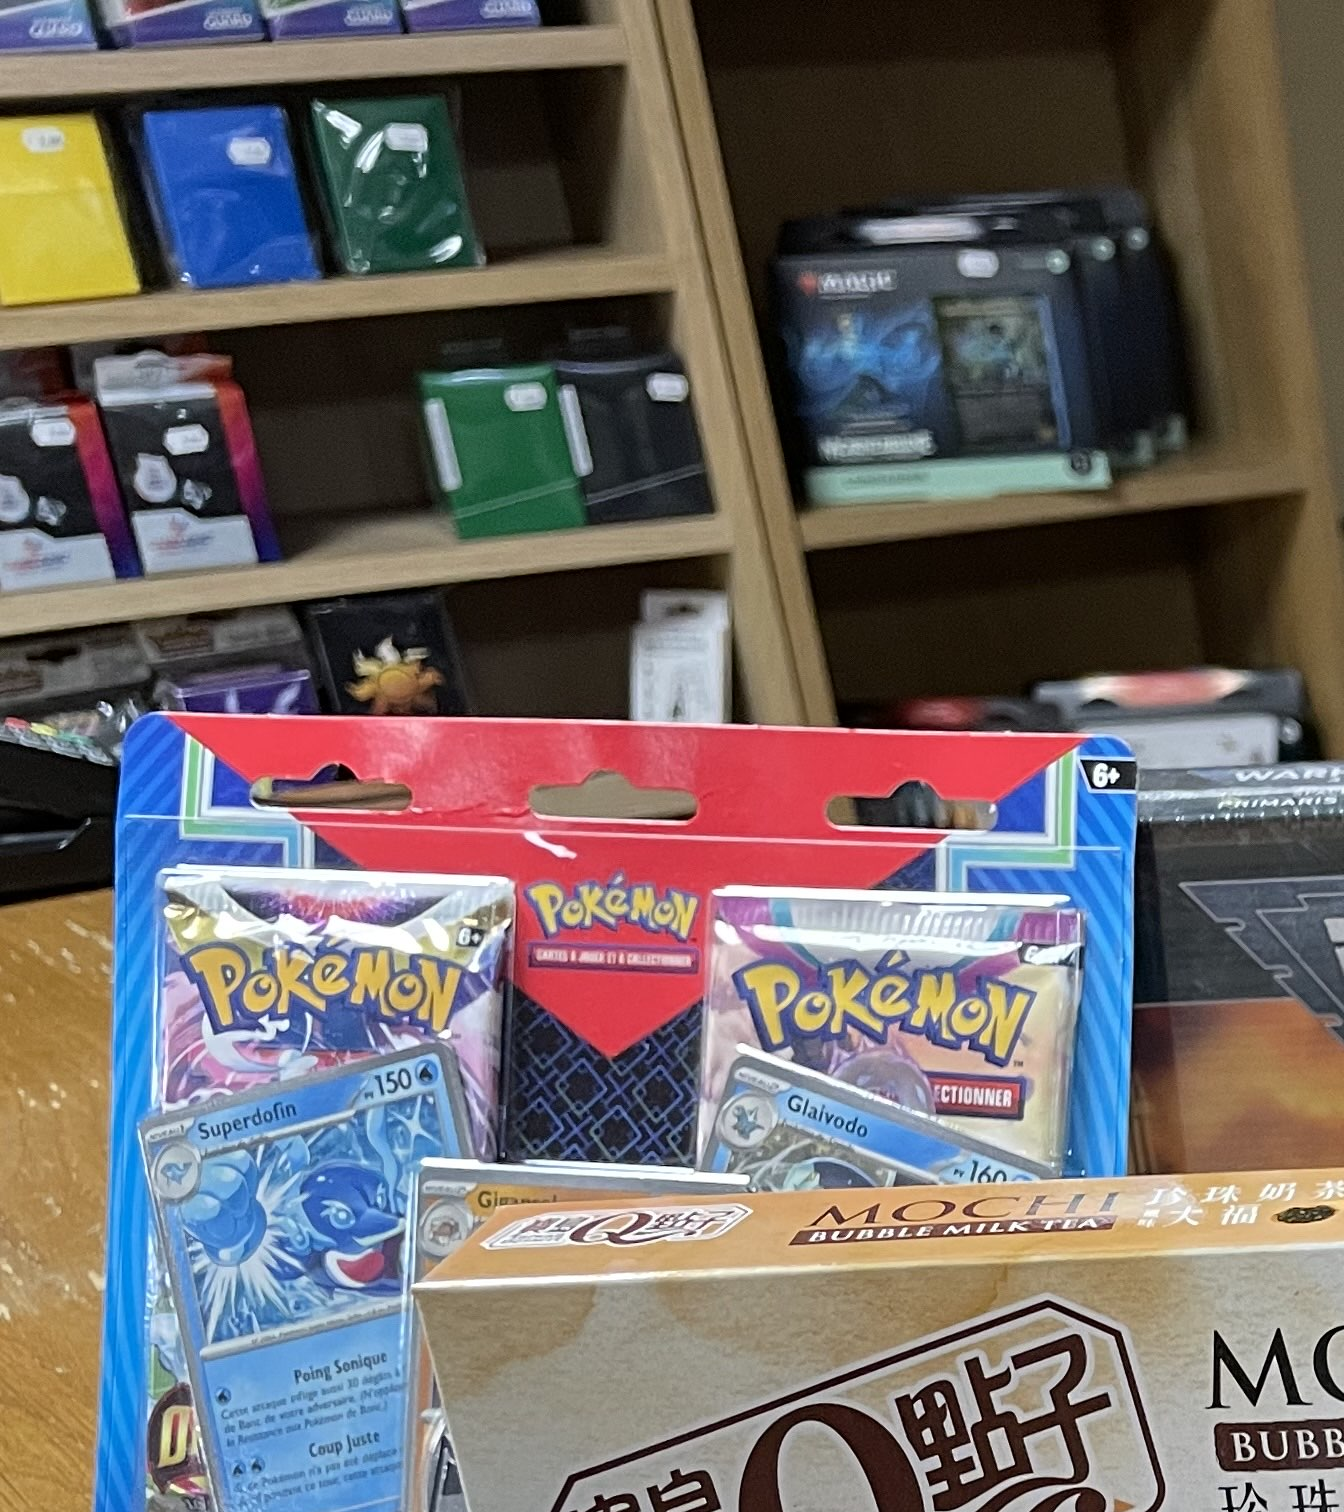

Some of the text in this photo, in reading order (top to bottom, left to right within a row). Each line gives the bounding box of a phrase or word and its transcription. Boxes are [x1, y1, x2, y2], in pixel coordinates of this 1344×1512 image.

[1092, 763, 1121, 788] 6+
[457, 927, 484, 947] 6+
[197, 1102, 298, 1141] Superdofin
[374, 1068, 412, 1097] 150
[933, 1083, 1013, 1109] ECTIONNER
[786, 1094, 869, 1139] Glaivodo
[969, 1159, 1008, 1182] 160
[804, 1191, 1121, 1228] MOCHI
[808, 1215, 1101, 1243] BUBBLE MILK TEA
[294, 1350, 388, 1386] Poing Sonique
[308, 1428, 381, 1459] Coup Juste
